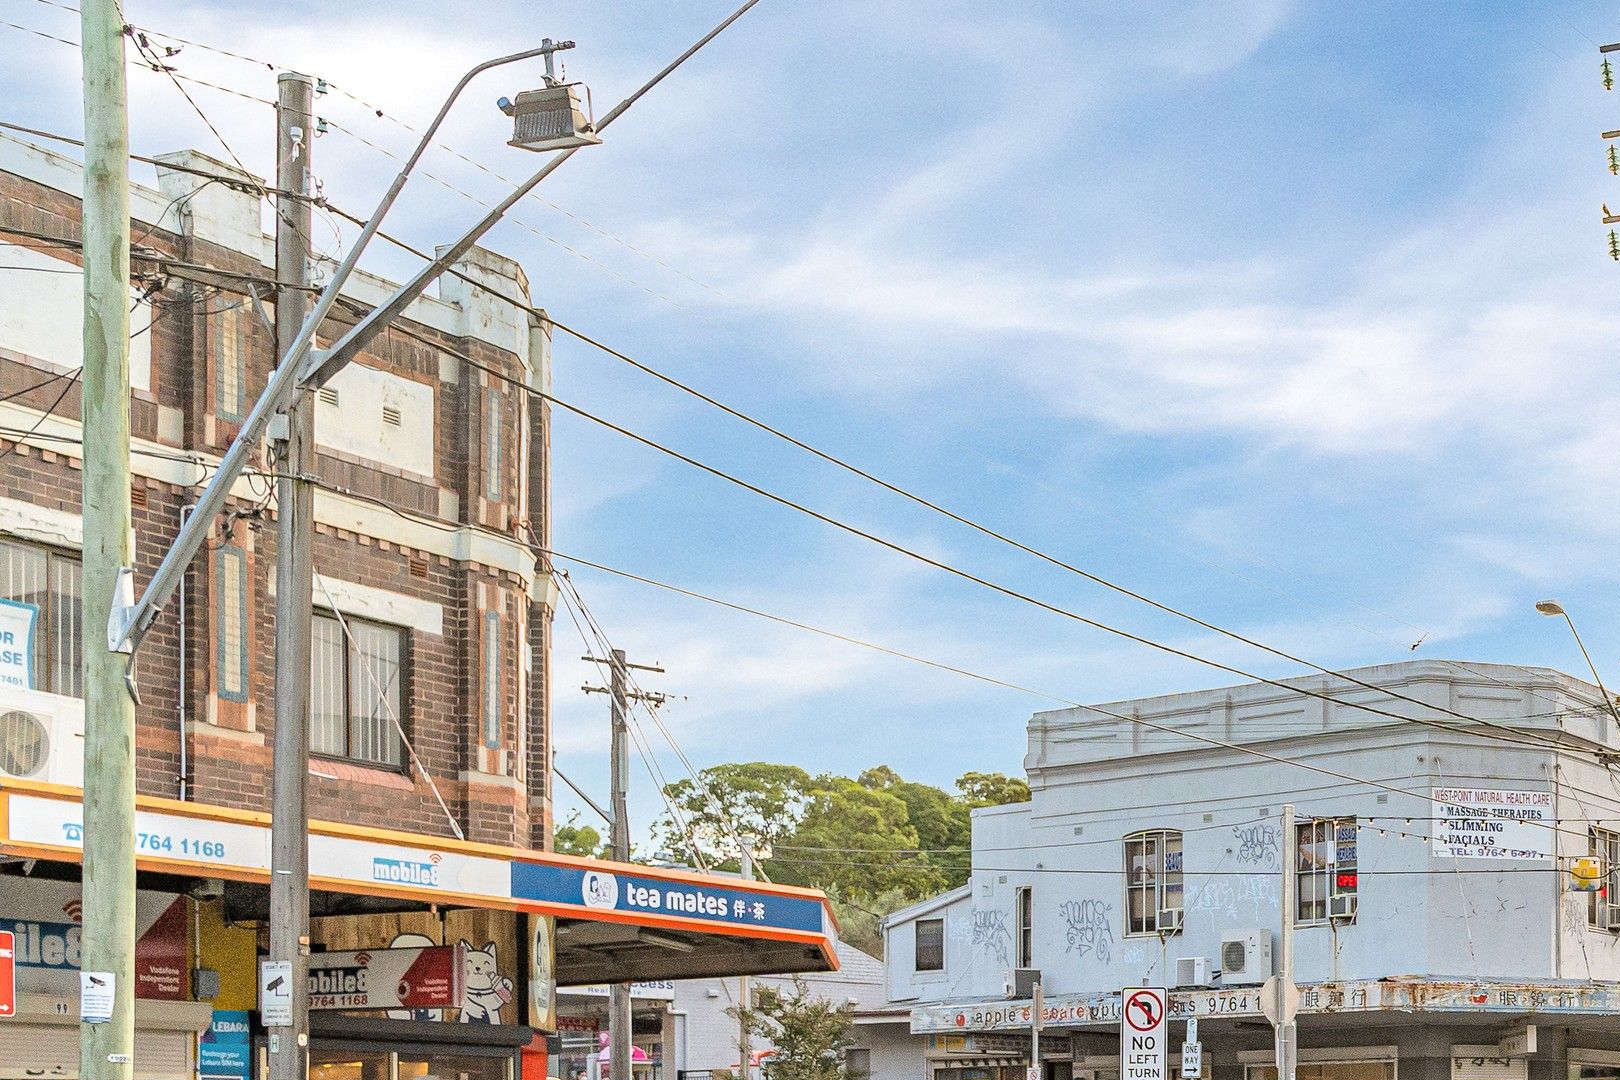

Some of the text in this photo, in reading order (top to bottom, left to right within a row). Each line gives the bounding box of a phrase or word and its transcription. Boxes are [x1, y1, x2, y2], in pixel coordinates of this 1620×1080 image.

[1434, 790, 1550, 805] WEST-POINT NATURAL HEALTH CARE
[1447, 806, 1542, 819] MASSAGE THERAPIES
[1449, 820, 1503, 832] SLIMMING
[1448, 835, 1495, 845] FACIALS
[180, 838, 225, 858] 1168
[1449, 847, 1473, 856] TEL:
[627, 882, 661, 909] tea
[666, 891, 728, 917] mates
[341, 994, 368, 1006] 1168
[976, 1009, 1016, 1026] apple
[213, 1021, 249, 1033] LEBARA
[1132, 1036, 1156, 1050] NO
[1185, 1045, 1198, 1053] ONE
[1129, 1054, 1158, 1064] LEFT
[1184, 1056, 1198, 1064] WAY
[1128, 1068, 1160, 1078] TURN
